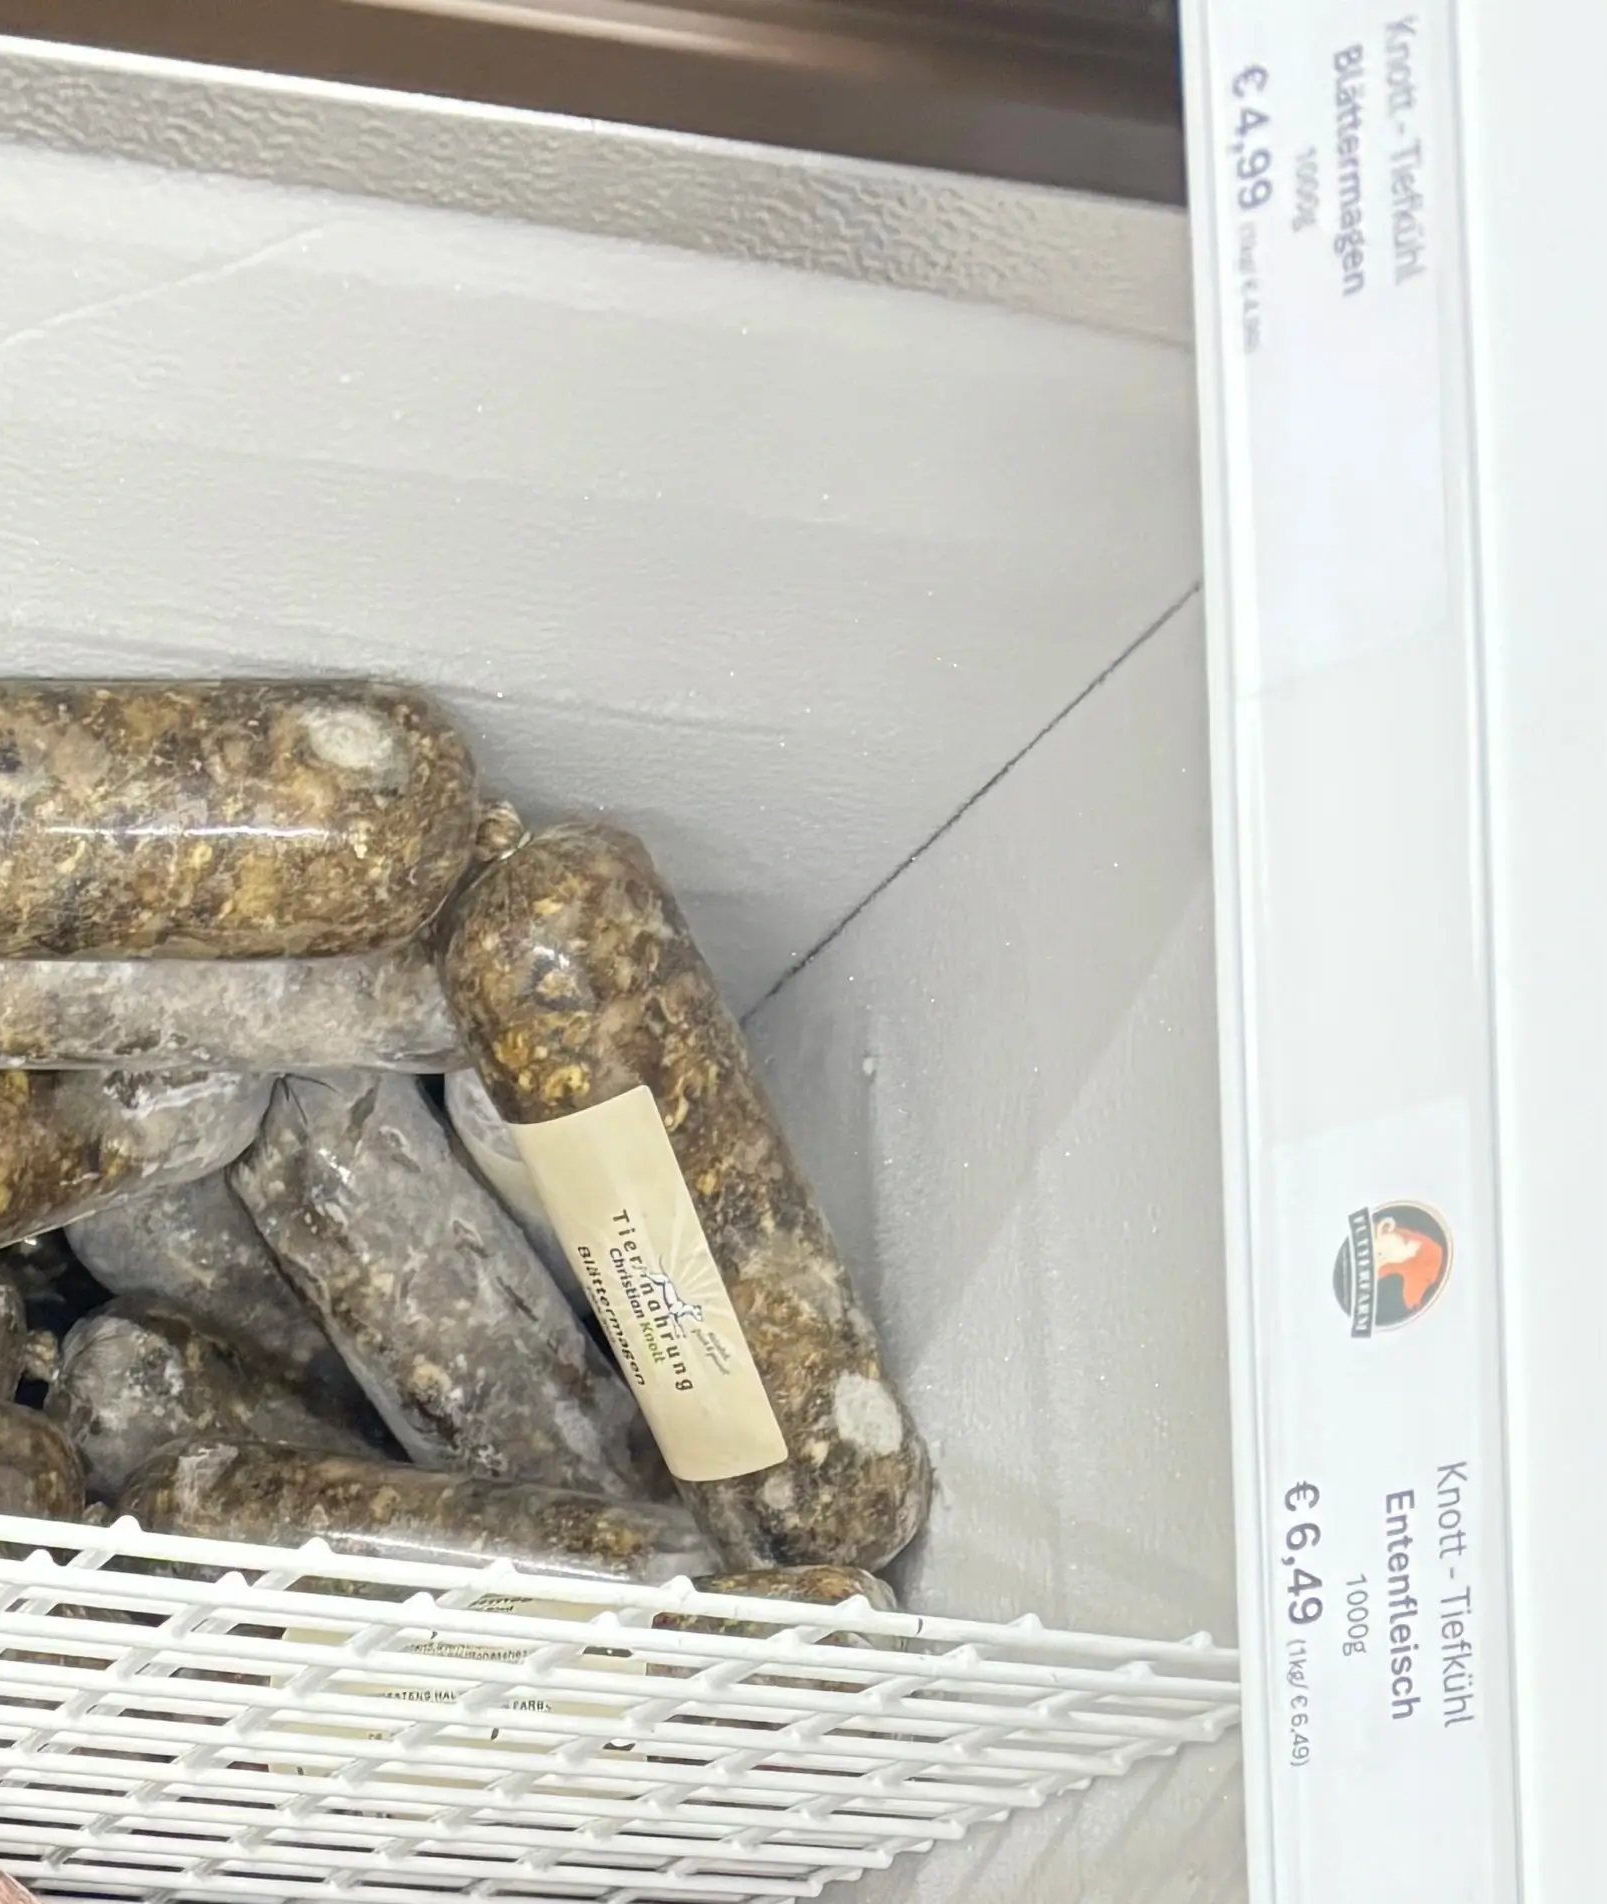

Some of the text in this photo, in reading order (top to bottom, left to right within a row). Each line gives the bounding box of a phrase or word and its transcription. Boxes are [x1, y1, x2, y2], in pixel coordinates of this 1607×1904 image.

[1232, 65, 1269, 98] €
[1231, 108, 1273, 210] 4,99
[1292, 146, 1319, 232] 1000g
[1334, 44, 1365, 296] Blättermagen
[578, 1247, 645, 1385] Blättermagen
[610, 1248, 666, 1363] Christian Knott
[1285, 1481, 1319, 1511] €
[1437, 1462, 1467, 1559] Knott
[1282, 1523, 1323, 1624] 6,49
[1342, 1574, 1369, 1656] 1000g
[1386, 1490, 1421, 1719] Entenfleisch
[1440, 1586, 1474, 1728] Tiefkühl
